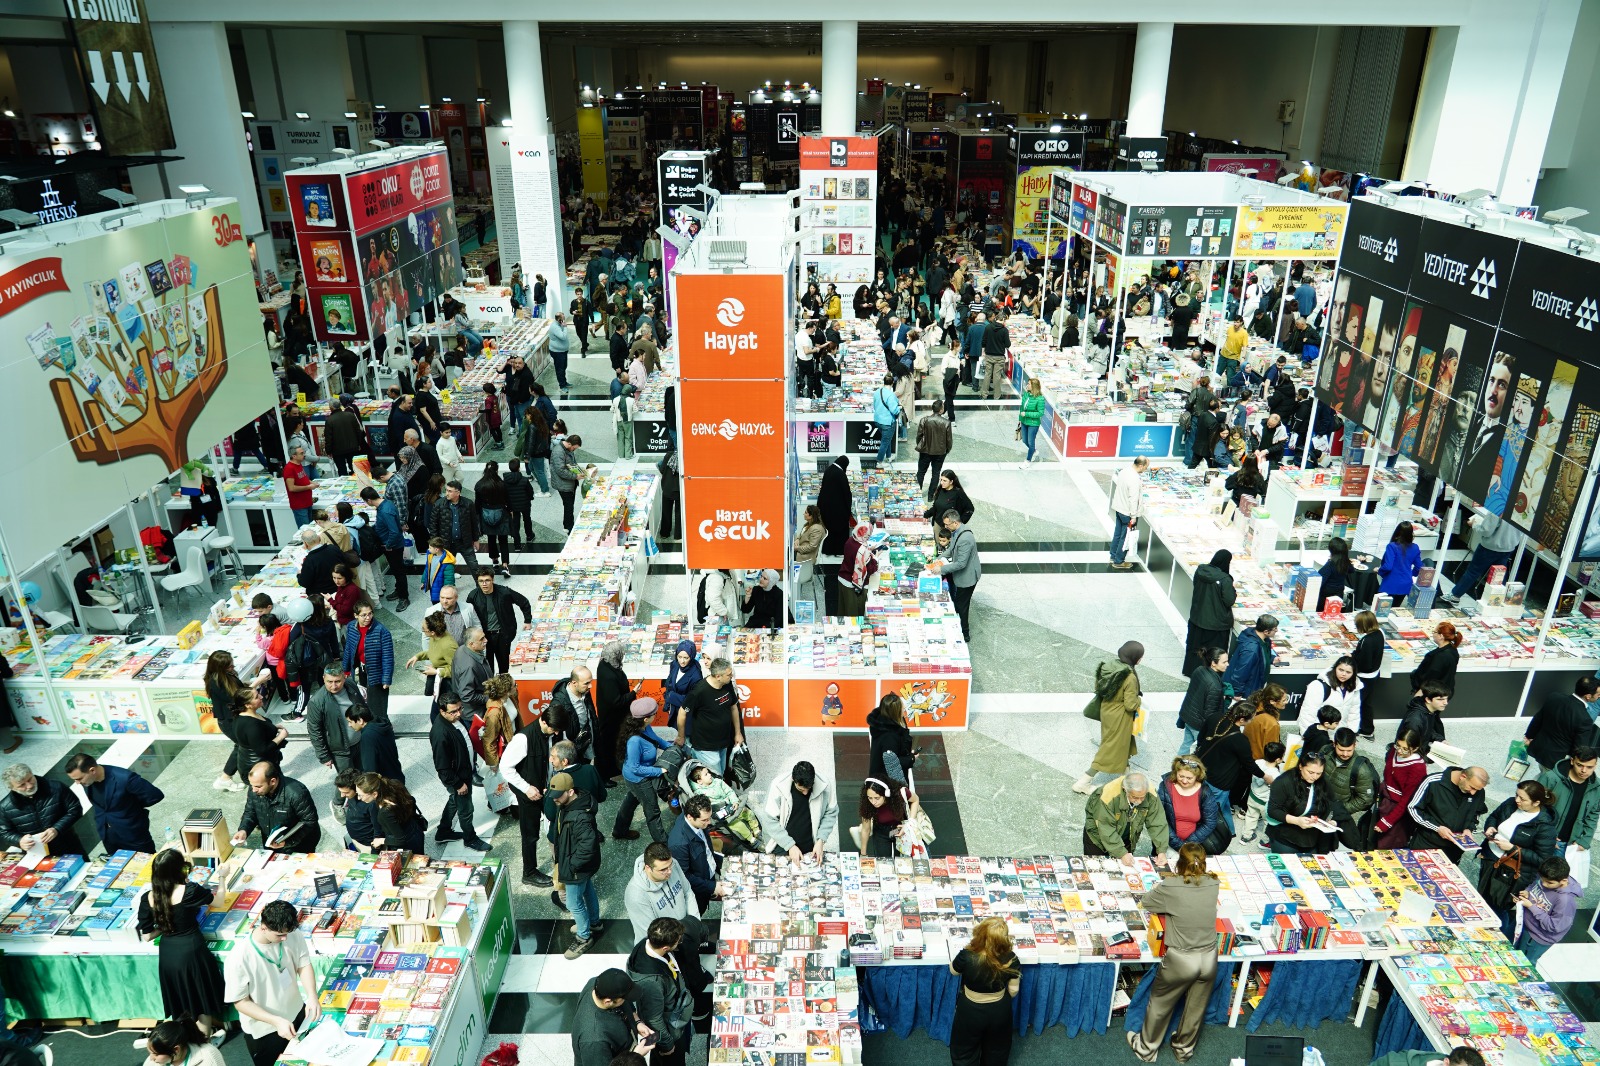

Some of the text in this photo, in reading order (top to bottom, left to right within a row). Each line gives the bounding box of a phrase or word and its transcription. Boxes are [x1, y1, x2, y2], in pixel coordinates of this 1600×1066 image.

[525, 150, 541, 158] can
[1021, 175, 1048, 195] Harry
[1079, 189, 1092, 203] ALFA
[1358, 234, 1384, 256] YEDİTEPE
[1422, 252, 1468, 286] YEDİTEPE
[4, 270, 57, 300] YAYINCILIK
[486, 305, 503, 313] can
[1531, 289, 1573, 320] YEDİTEPE
[704, 331, 758, 355] Hayat
[716, 509, 753, 522] Hayat
[481, 917, 508, 994] kadim
